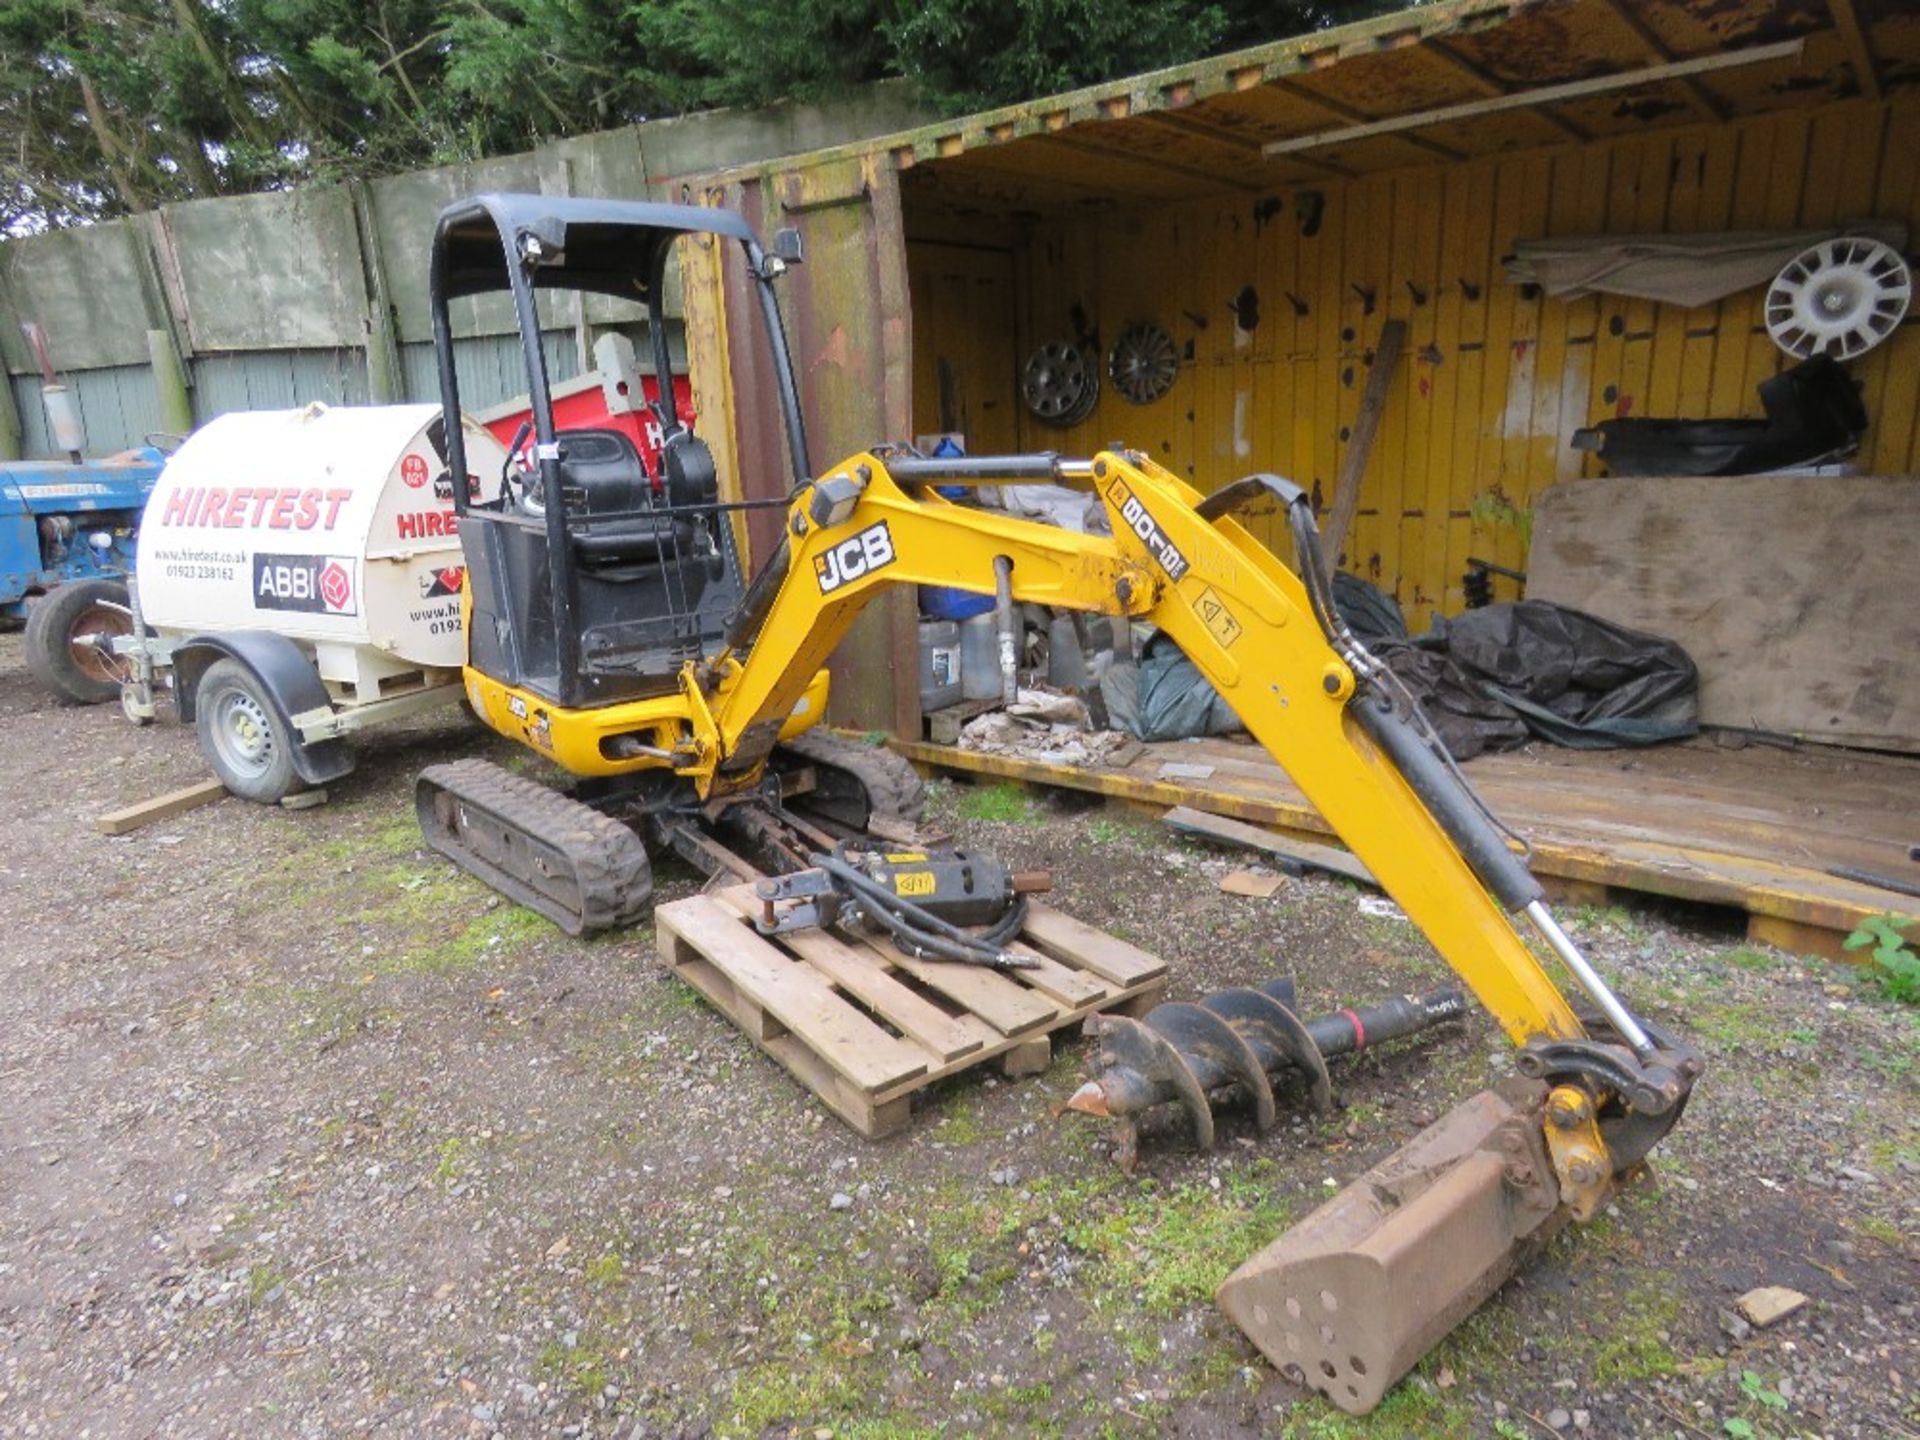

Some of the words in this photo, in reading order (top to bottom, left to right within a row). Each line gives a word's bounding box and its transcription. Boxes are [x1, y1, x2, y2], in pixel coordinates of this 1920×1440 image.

[162, 487, 353, 531] HIRETEST
[397, 511, 460, 539] HIRE
[1123, 496, 1180, 573] 8018
[155, 548, 247, 564] www.hiretest.co.uk
[819, 525, 894, 592] JCB
[166, 565, 195, 579] 01923
[260, 566, 316, 600] ABBI
[410, 602, 460, 622] www.hi
[430, 620, 462, 634] 0192
